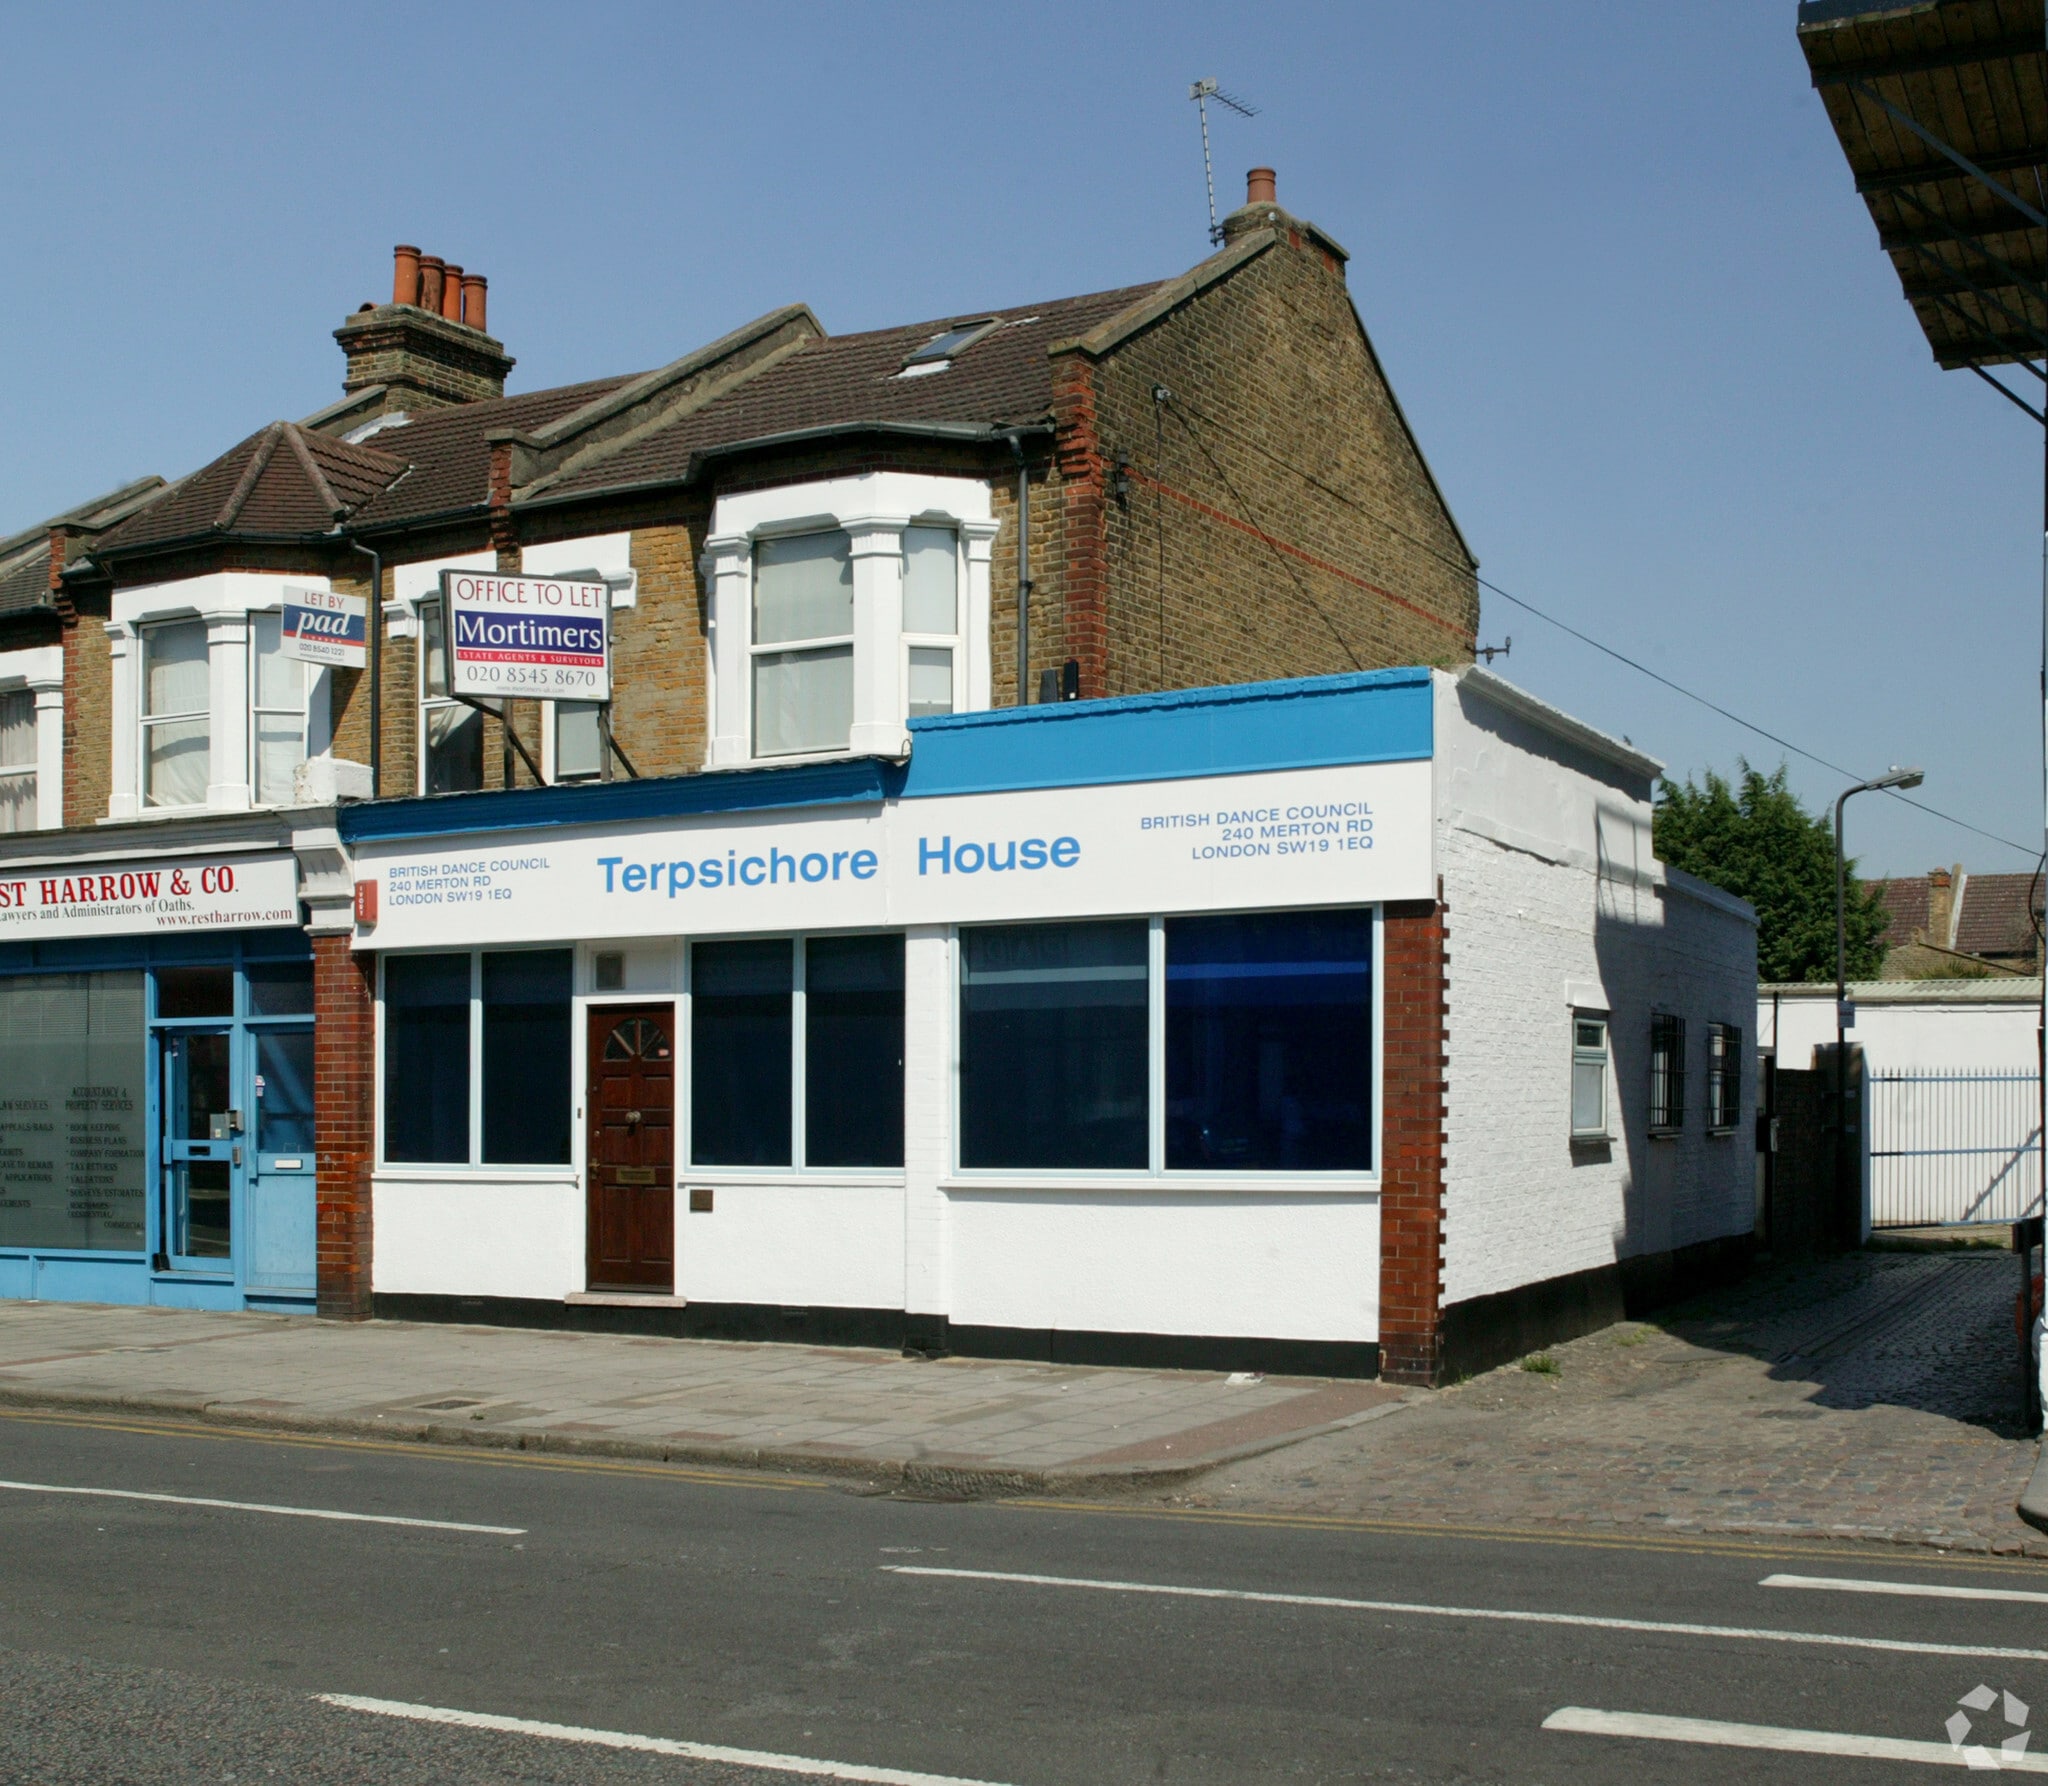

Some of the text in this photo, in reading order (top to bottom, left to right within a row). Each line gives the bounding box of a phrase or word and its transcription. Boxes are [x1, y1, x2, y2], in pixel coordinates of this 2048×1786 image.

[304, 592, 344, 610] LET BY
[456, 578, 602, 608] OFFICE TO LET
[296, 611, 350, 638] pad
[458, 615, 602, 650] Mortimers
[458, 650, 493, 660] ESTATE
[498, 652, 536, 662] AGENTS
[550, 656, 602, 666] SURVEYORS
[467, 666, 596, 686] 020 8545 8670
[1141, 802, 1373, 830] BRITISH DANCE COUNCIL
[1222, 820, 1373, 841] 240 MERTON RD
[1192, 836, 1373, 860] LONDON SW19 1EQ
[389, 858, 550, 878] BRITISH DANCE COUNCIL
[597, 835, 1080, 898] Terpsichore House
[40, 872, 161, 905] HARROW
[170, 869, 192, 896] &
[202, 866, 239, 894] CO.
[389, 876, 492, 892] 240 MERTON RD
[389, 888, 512, 906] LONDON SW19 1EQ
[40, 906, 60, 920] and
[62, 903, 142, 918] Administrators
[145, 900, 156, 913] of
[156, 908, 292, 926] www.restharrow.com
